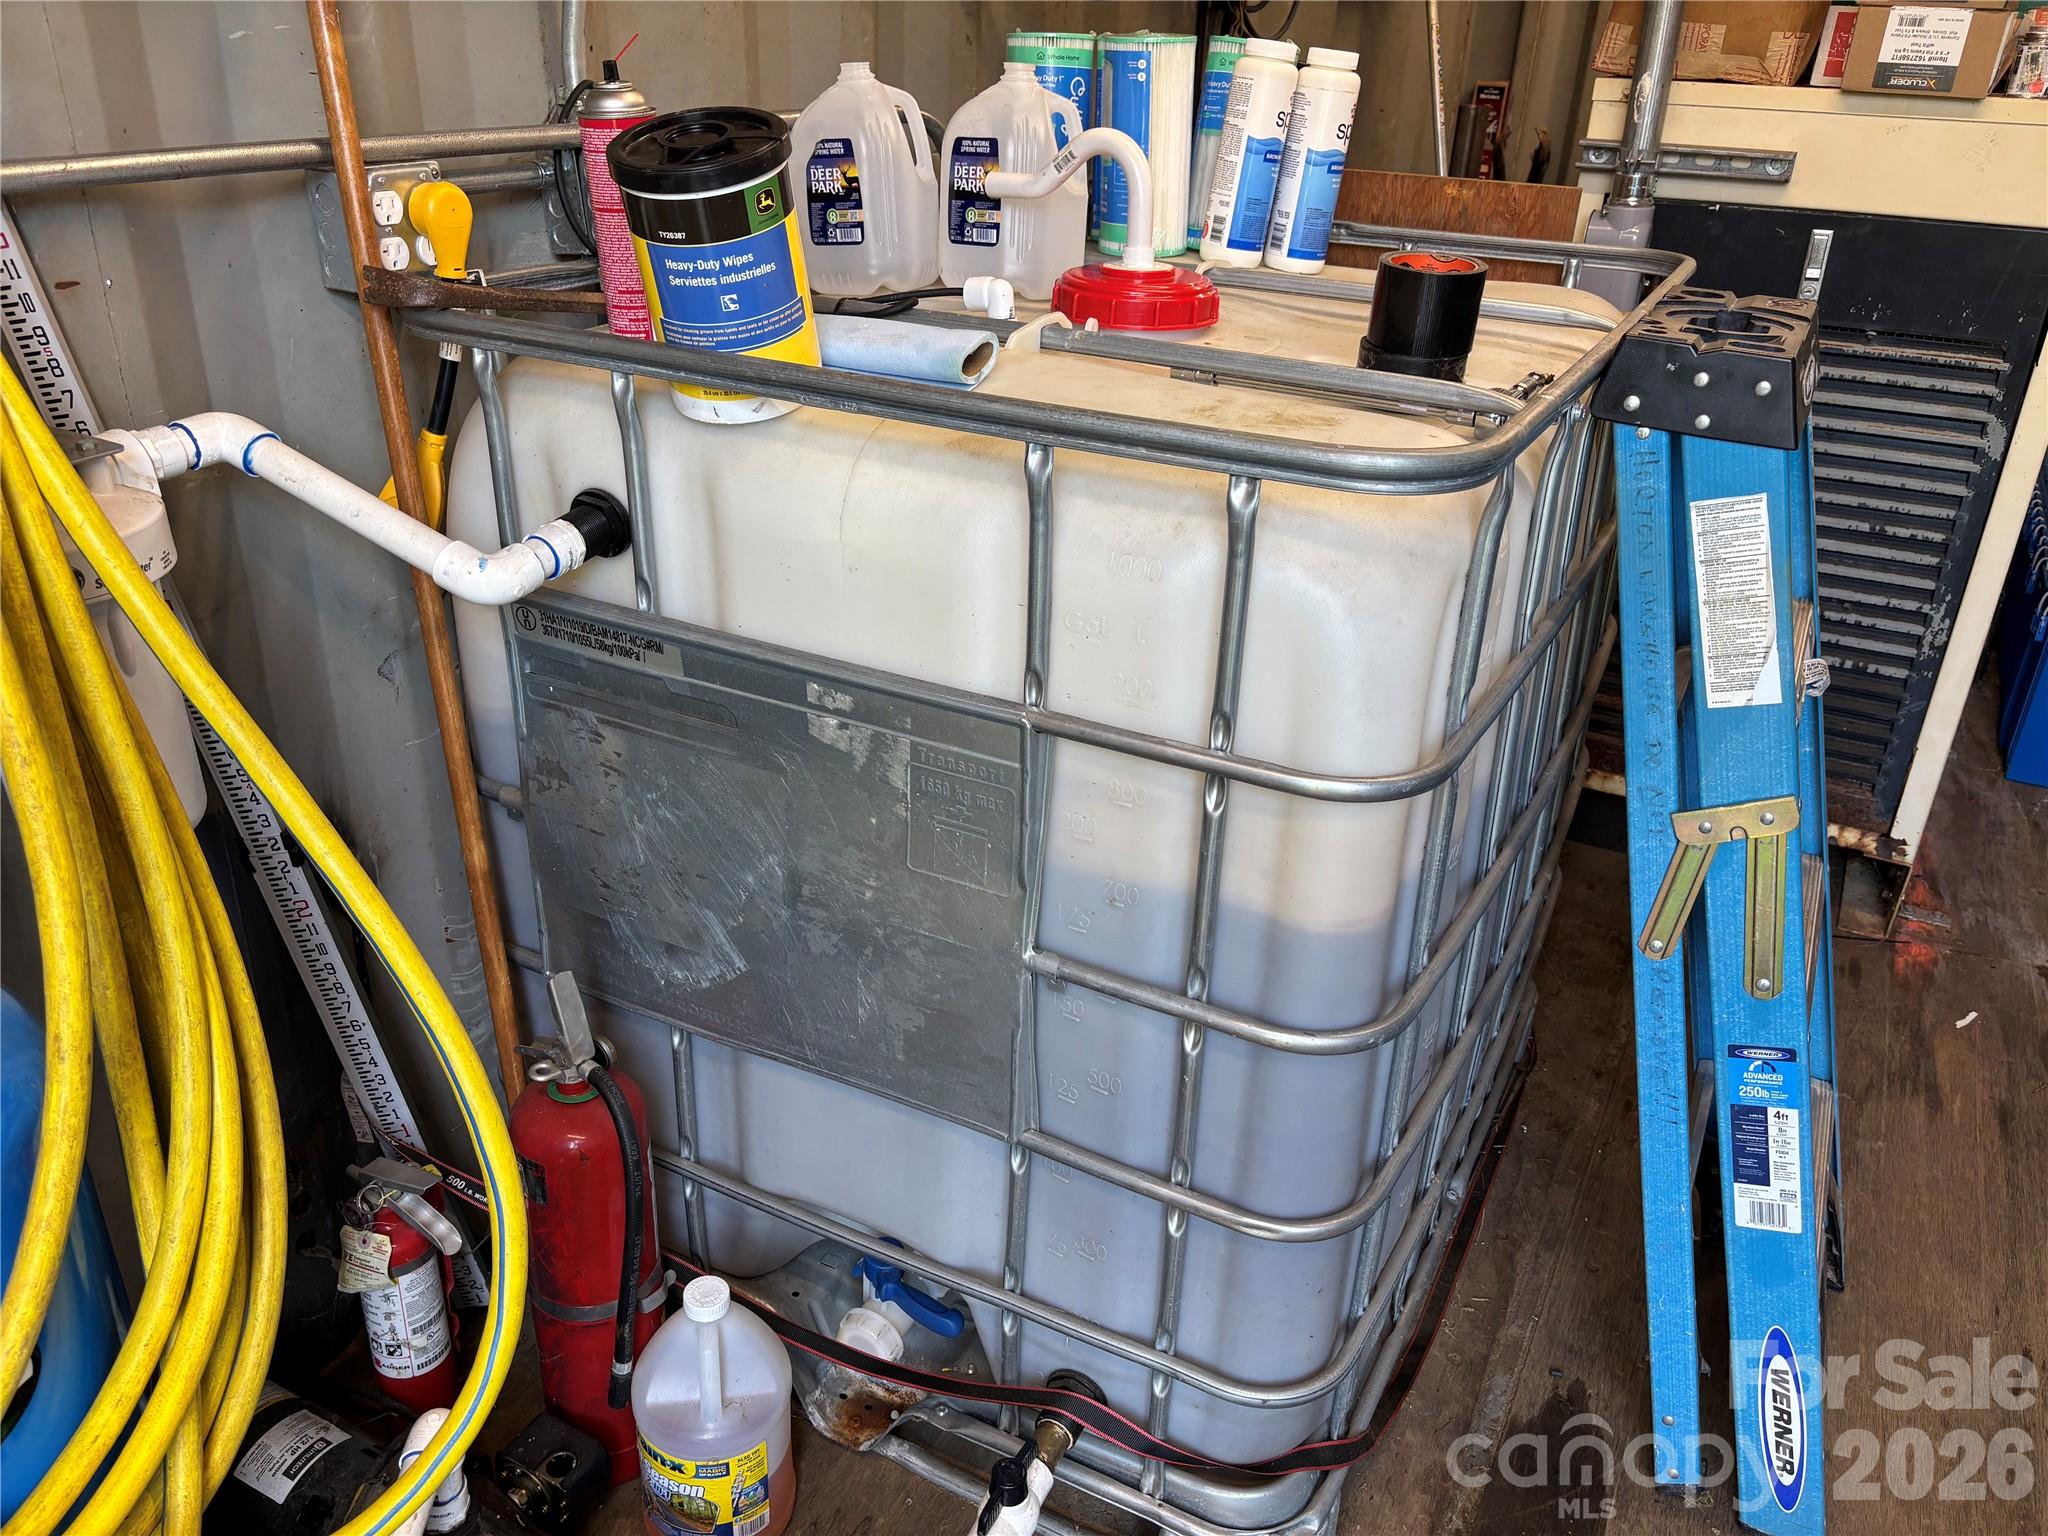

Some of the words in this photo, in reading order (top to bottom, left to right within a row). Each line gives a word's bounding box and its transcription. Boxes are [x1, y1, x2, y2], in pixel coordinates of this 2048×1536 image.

[1047, 53, 1065, 61] Whole
[1043, 75, 1058, 83] Duty
[810, 167, 842, 181] DEER
[954, 165, 985, 179] DEER
[812, 181, 844, 195] PARK
[953, 178, 985, 194] PARK
[658, 230, 687, 240] TY26387
[2, 258, 23, 281] 11
[664, 258, 721, 273] Heavy-Duty
[722, 252, 754, 268] Wipes
[668, 275, 718, 288] Serviettes
[719, 261, 777, 286] industrielles
[17, 292, 37, 314] 10
[32, 325, 50, 346] 9
[47, 357, 65, 378] 8
[61, 389, 74, 409] 7
[75, 420, 92, 436] 6
[917, 746, 1007, 783] Transport
[249, 791, 262, 806] 4
[920, 775, 951, 800] 1650
[955, 786, 972, 807] kg
[976, 794, 1004, 812] max
[257, 813, 272, 828] 3
[267, 837, 281, 852] 2
[277, 860, 291, 875] 2
[288, 881, 299, 895] 1
[1103, 878, 1140, 905] 700
[293, 899, 313, 919] 2
[1055, 903, 1092, 929] 175
[305, 922, 320, 936] 11
[314, 943, 329, 956] 10
[323, 962, 337, 976] 9
[332, 981, 346, 995] 8
[341, 1000, 352, 1014] 7
[350, 1018, 363, 1032] 6
[358, 1038, 371, 1050] 5
[368, 1056, 379, 1068] 4
[375, 1073, 387, 1086] 3
[1049, 1072, 1080, 1100] 125
[1087, 1066, 1123, 1094] 500
[1743, 1071, 1784, 1081] ADVANCED
[382, 1091, 395, 1103] 2
[1738, 1085, 1770, 1098] 250lb
[391, 1108, 401, 1120] 1
[1773, 1110, 1789, 1121] 4ft
[400, 1123, 412, 1138] 1
[446, 1174, 467, 1191] 500
[1769, 1365, 1799, 1477] WERNER
[302, 1434, 314, 1446] 1/2
[290, 1445, 302, 1457] HP
